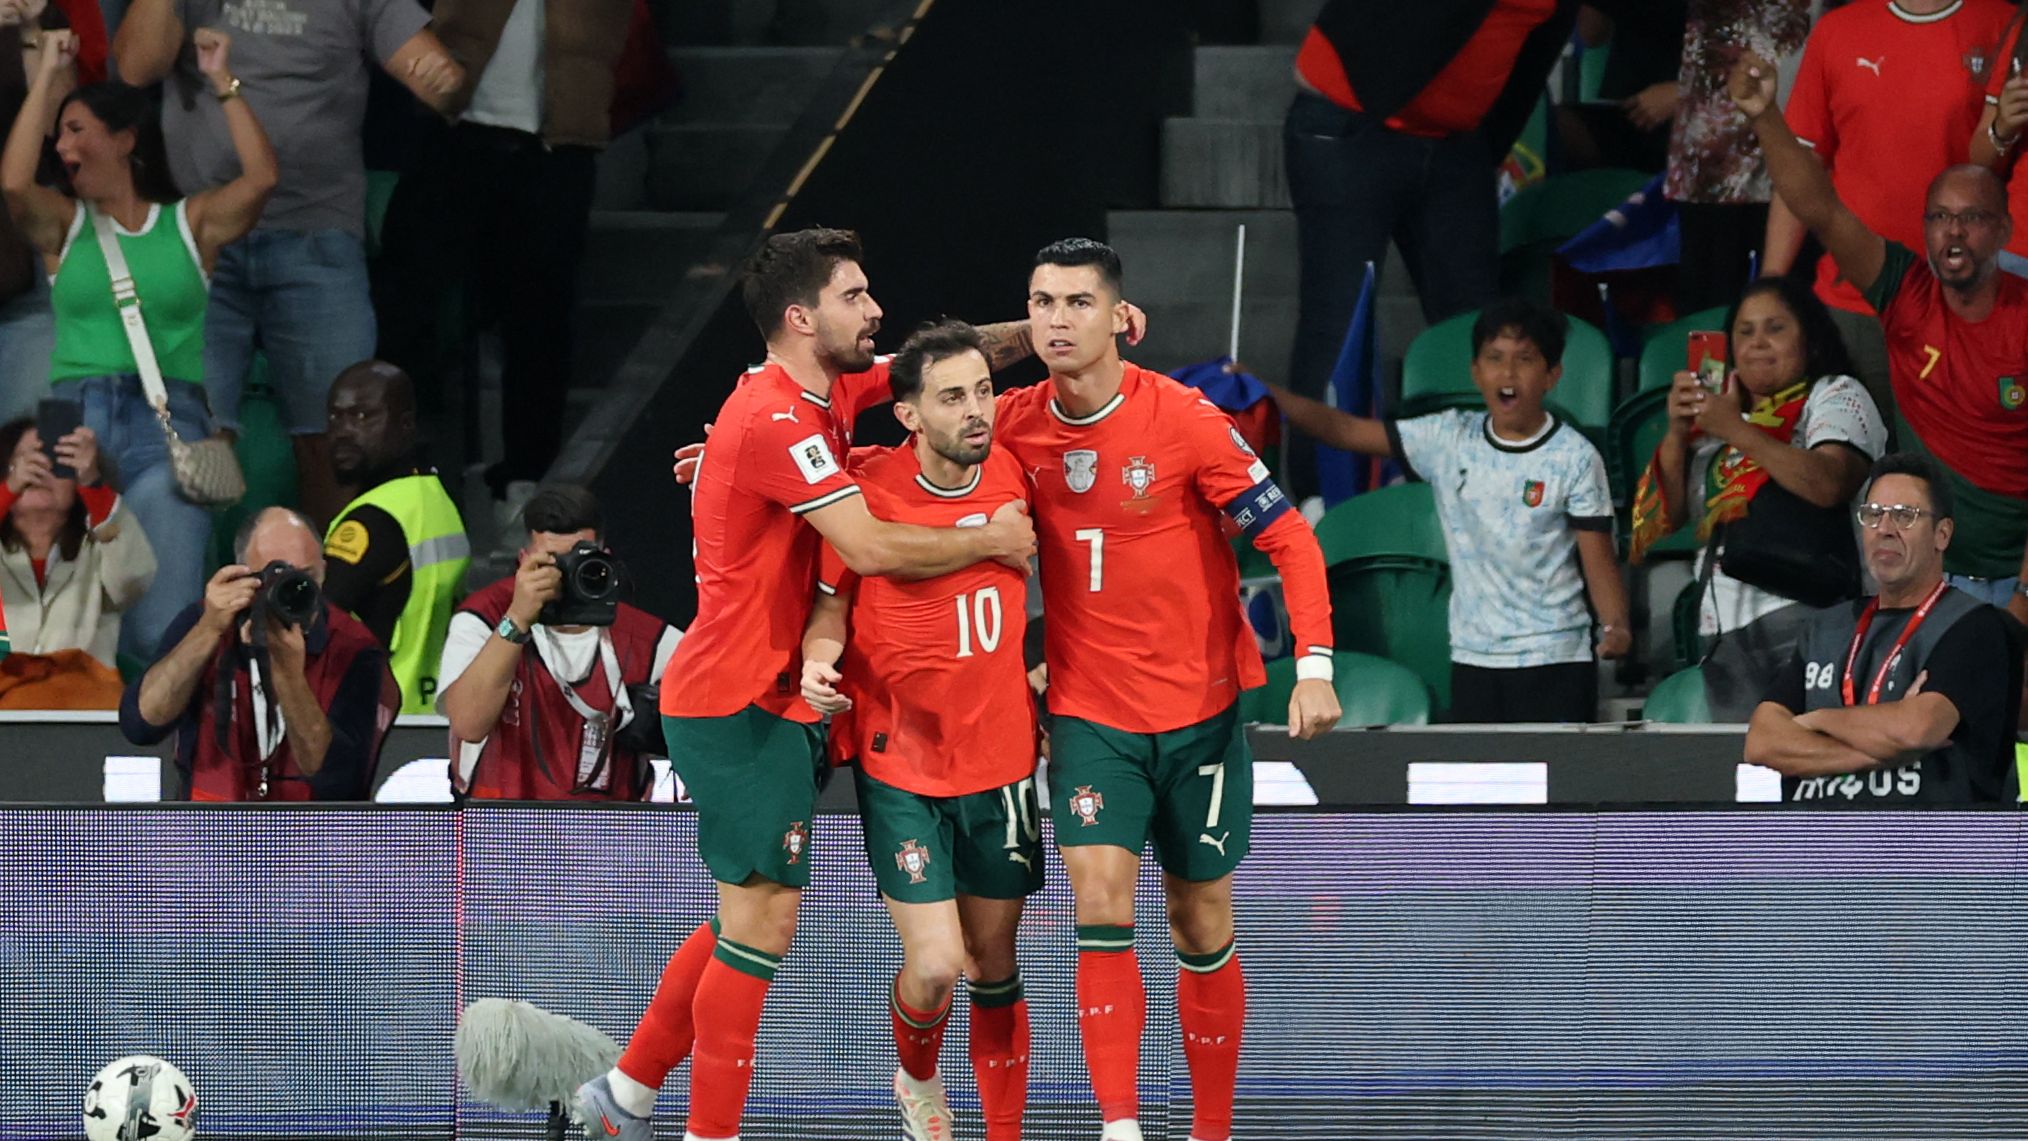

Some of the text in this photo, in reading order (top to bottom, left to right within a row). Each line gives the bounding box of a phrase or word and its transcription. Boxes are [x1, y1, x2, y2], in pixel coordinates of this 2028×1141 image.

[1920, 344, 1941, 378] 7
[1075, 528, 1104, 592] 7
[955, 586, 1002, 658] 10
[1805, 661, 1834, 689] 98
[1002, 776, 1039, 848] 10
[1199, 762, 1224, 828] 7
